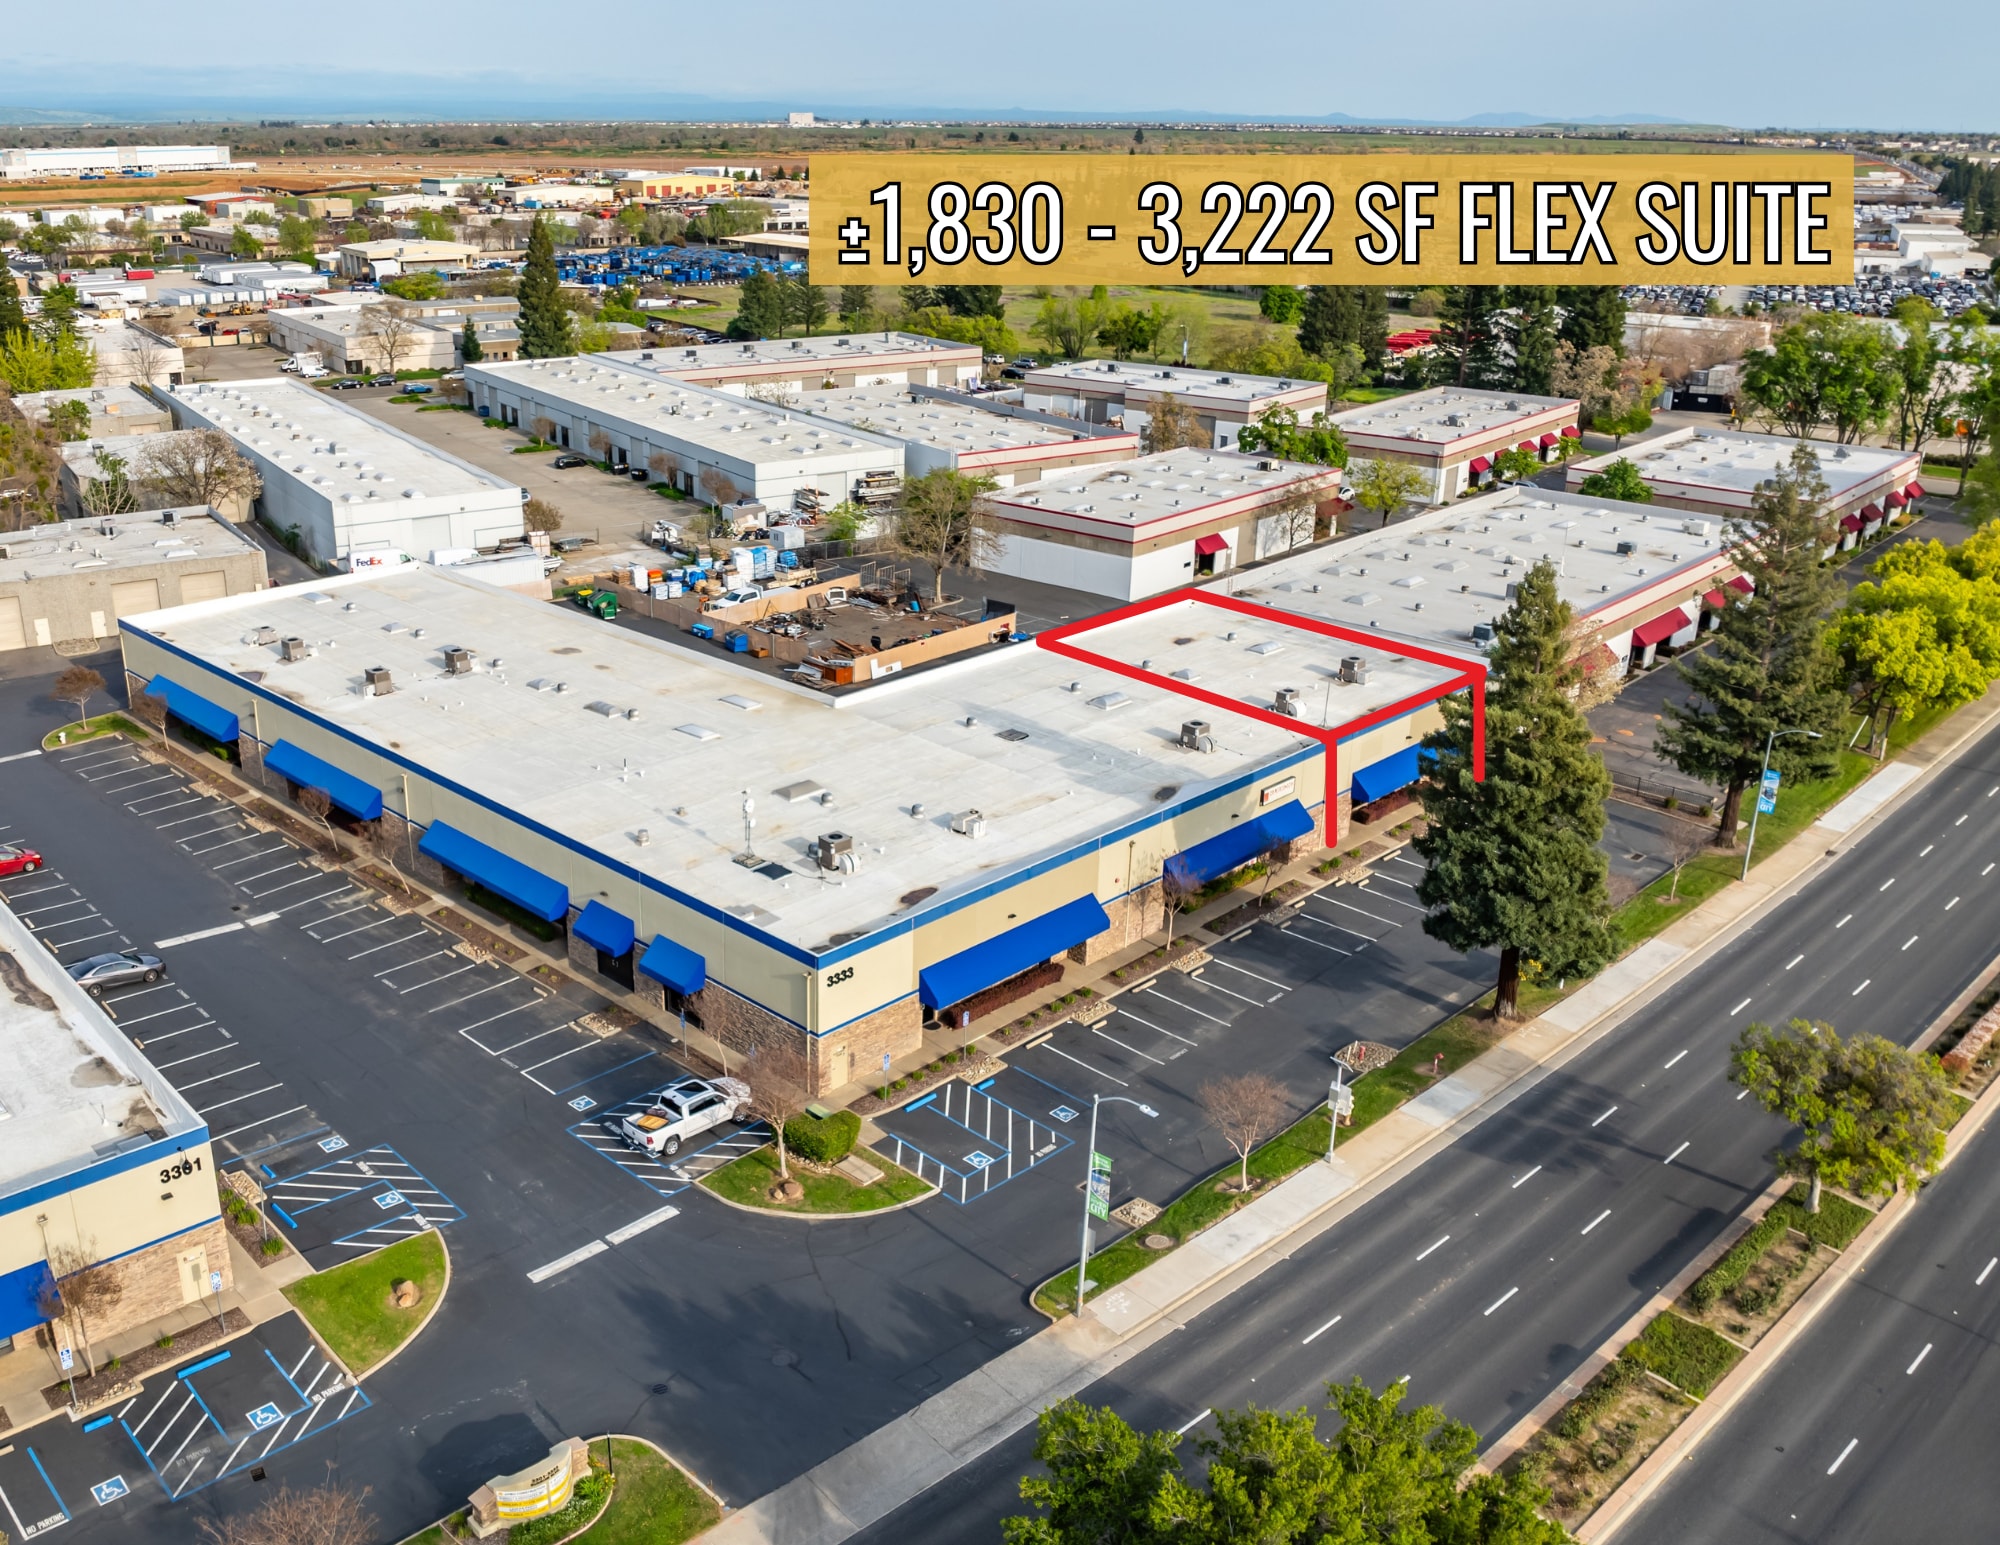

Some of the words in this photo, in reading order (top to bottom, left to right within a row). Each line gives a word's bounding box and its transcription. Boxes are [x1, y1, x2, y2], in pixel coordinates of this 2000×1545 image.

[356, 557, 383, 567] FedEx
[827, 966, 854, 987] 3333
[25, 1524, 37, 1536] NO
[36, 1512, 65, 1531] PARKING
